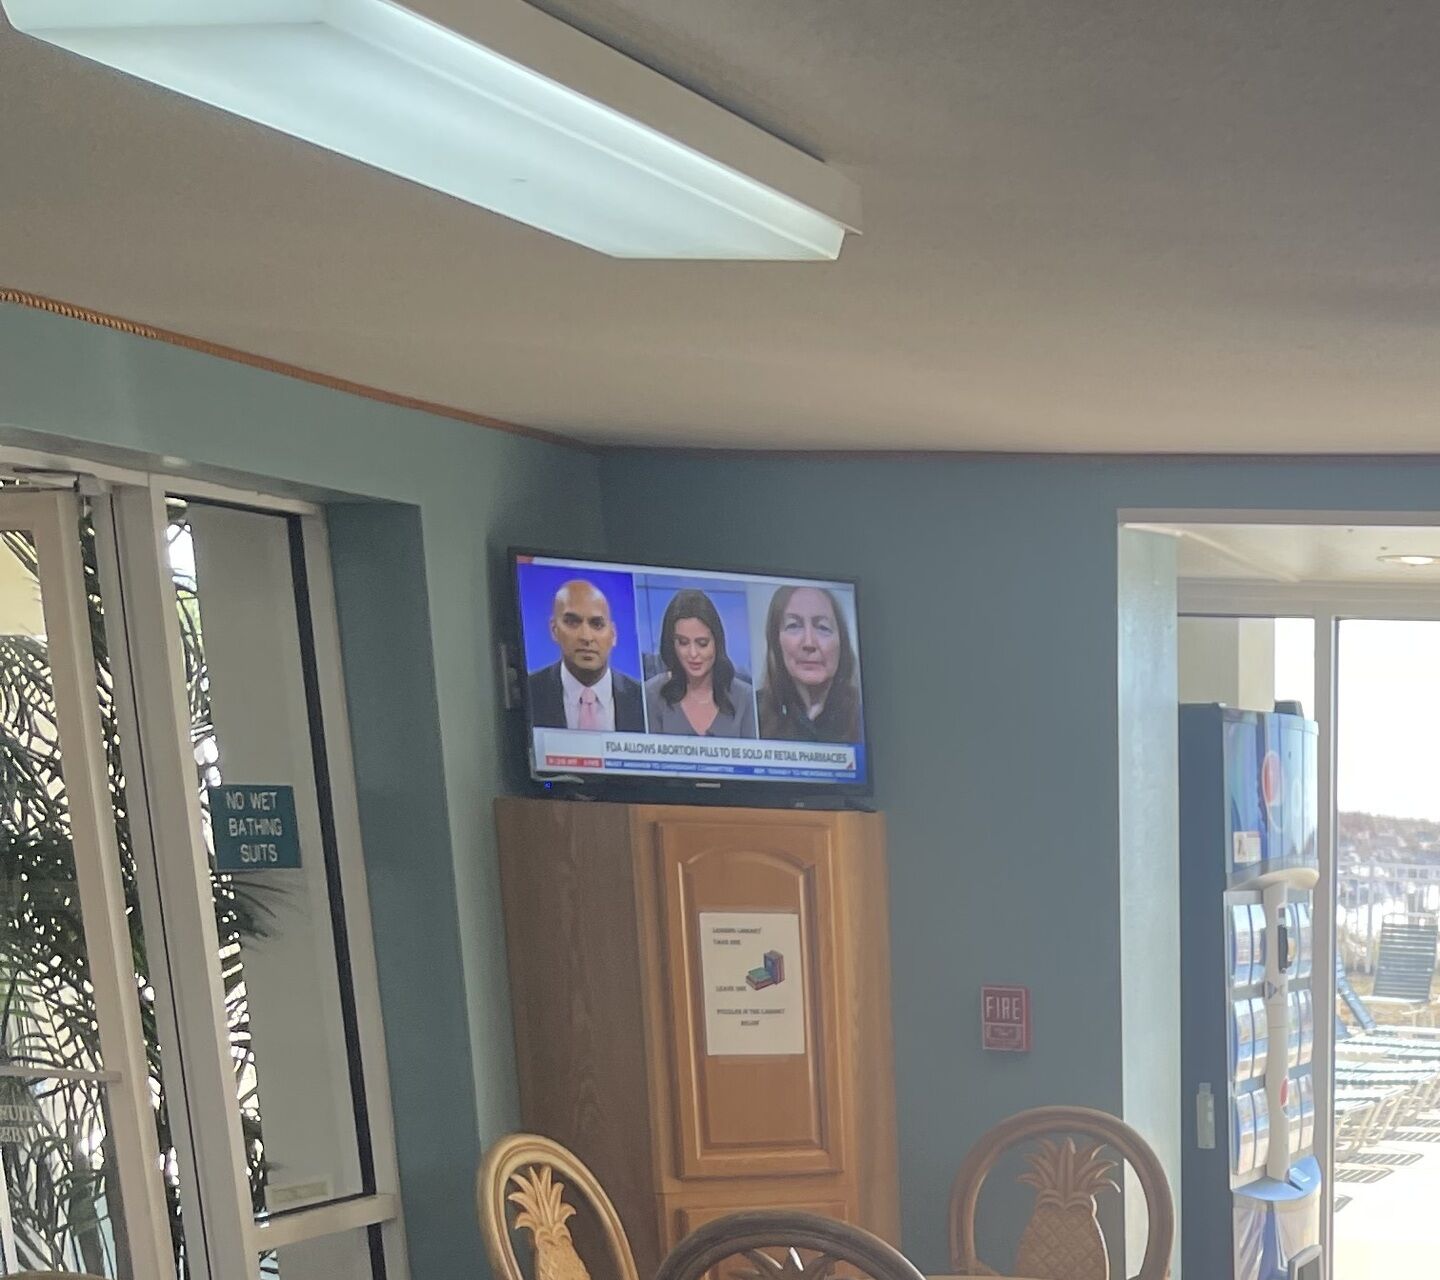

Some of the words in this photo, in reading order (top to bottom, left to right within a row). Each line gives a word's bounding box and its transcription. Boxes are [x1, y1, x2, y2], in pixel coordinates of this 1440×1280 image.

[605, 741, 623, 753] FDA
[623, 742, 656, 754] ALLOWS
[657, 743, 698, 757] ABORTION
[699, 746, 719, 758] PILLS
[720, 747, 730, 758] TO
[732, 748, 741, 759] BE
[742, 748, 763, 760] SOLD
[764, 749, 772, 760] AT
[774, 750, 797, 762] RETAIL
[799, 751, 848, 764] PHARMACIES
[225, 791, 245, 810] NO
[249, 791, 278, 811] WET
[228, 817, 283, 837] BATHING
[240, 843, 278, 863] SUITS
[985, 995, 1020, 1020] FIRE
